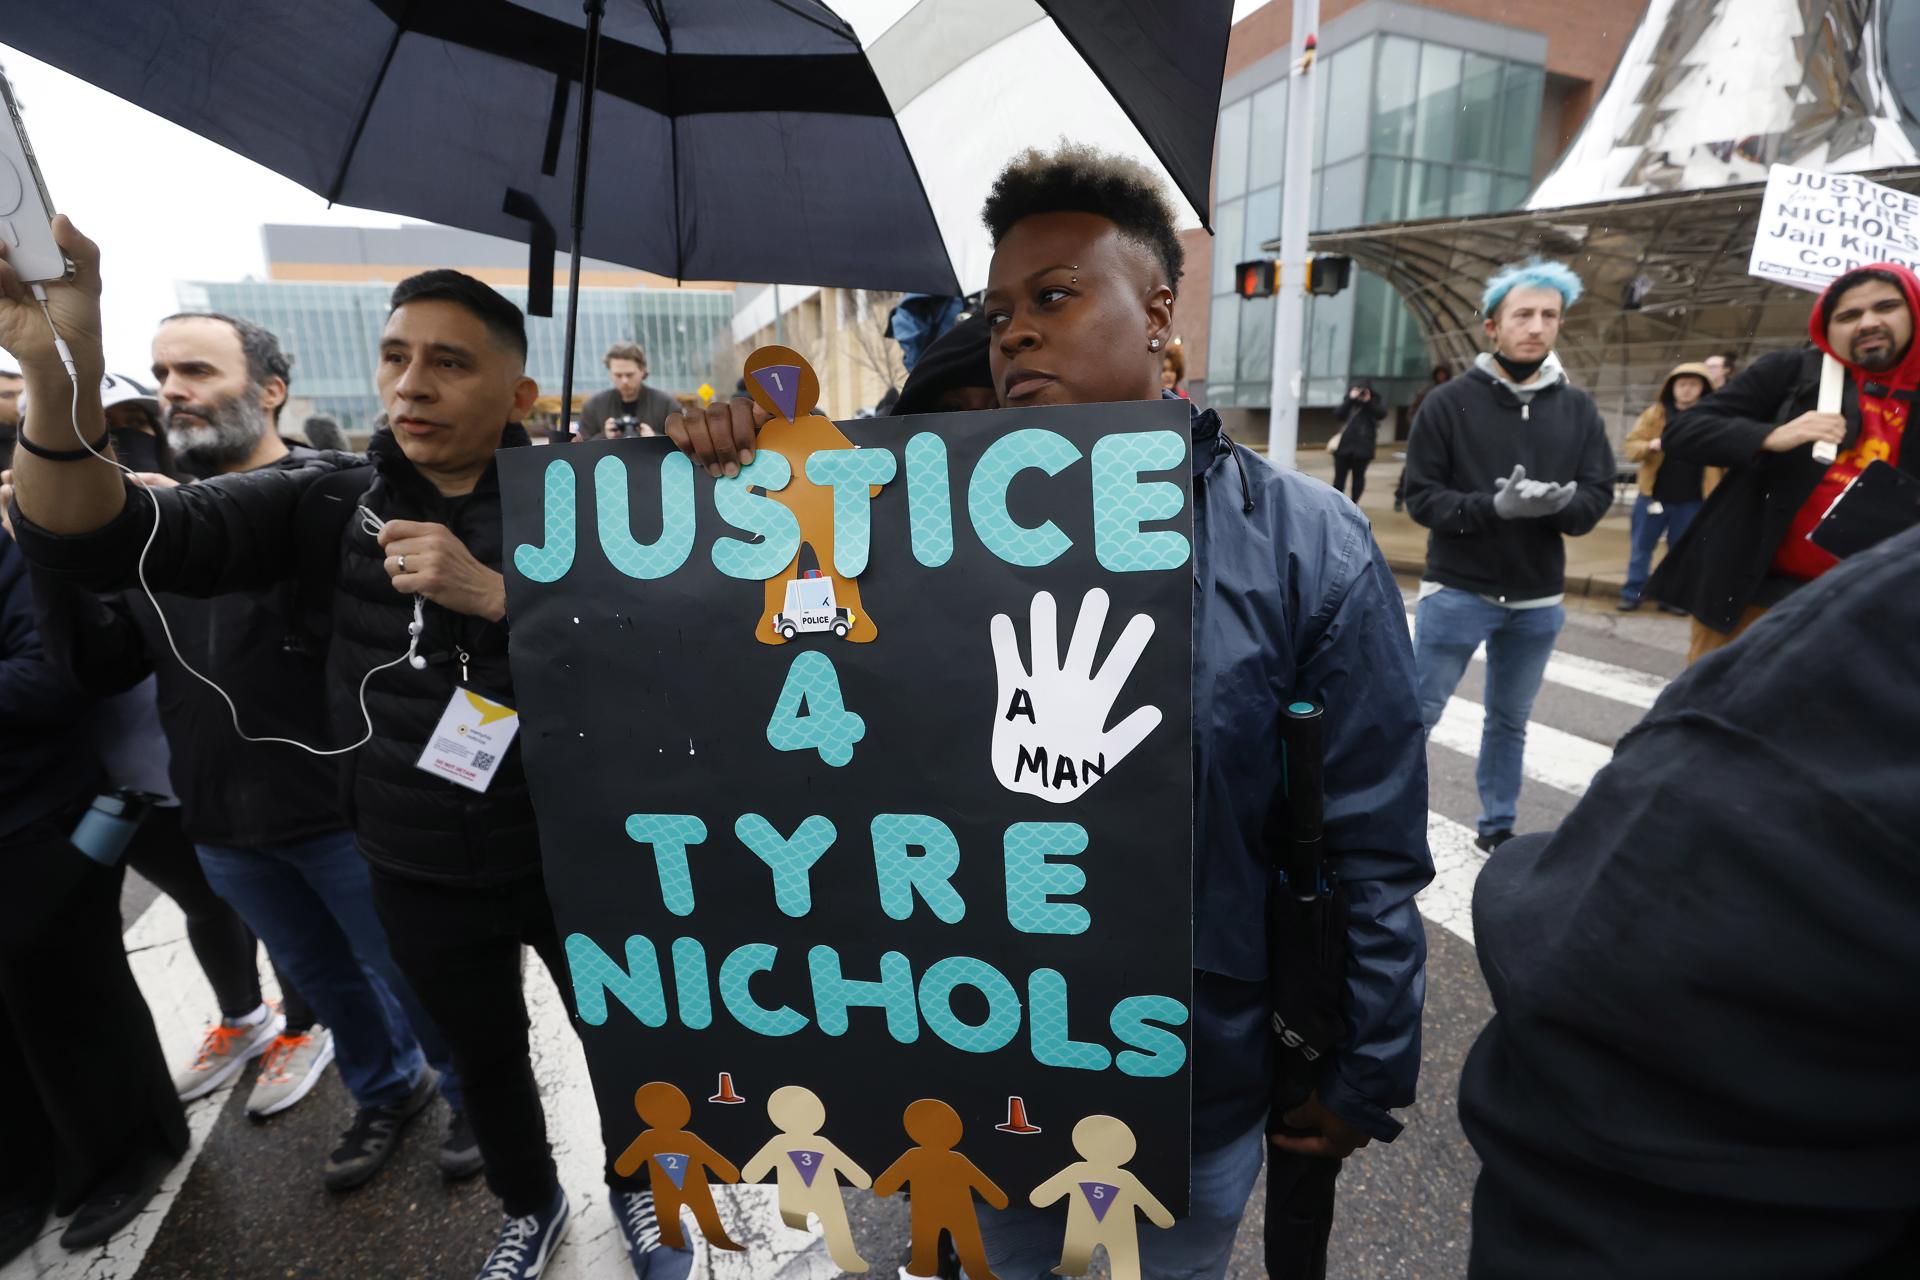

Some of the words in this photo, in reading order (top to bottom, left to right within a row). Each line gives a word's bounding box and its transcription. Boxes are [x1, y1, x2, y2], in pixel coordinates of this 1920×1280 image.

[1787, 172, 1919, 215] JUSTICE
[1777, 203, 1919, 250] NICHOLS
[1831, 195, 1911, 231] TYRE
[1770, 222, 1825, 247] Jail
[771, 372, 784, 392] 1
[513, 428, 1190, 582] JUSTICE
[802, 616, 829, 624] POLICE
[766, 650, 866, 767] 4
[1006, 688, 1036, 725] A
[1014, 744, 1105, 790] MAN
[625, 813, 1091, 935] TYRE
[565, 932, 1189, 1077] NICHOLS
[666, 1157, 679, 1169] 2
[801, 1153, 812, 1166] 3
[1092, 1186, 1104, 1199] 5
